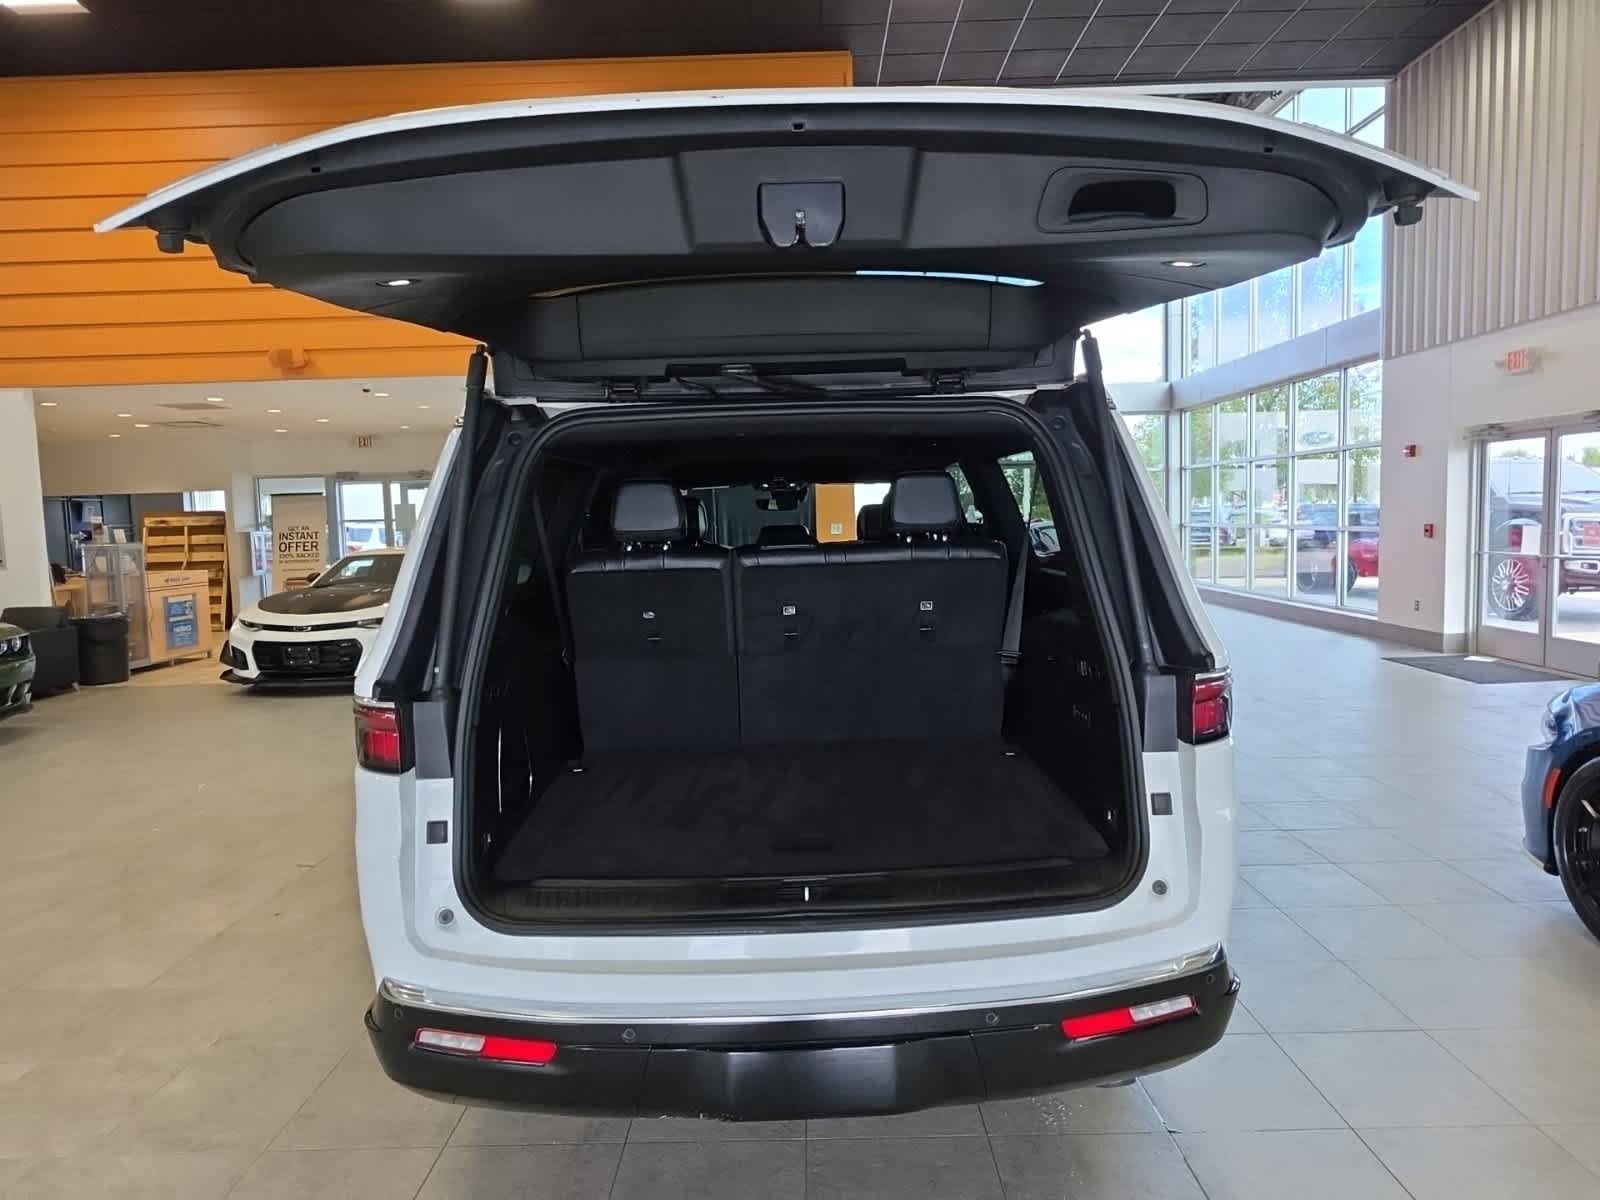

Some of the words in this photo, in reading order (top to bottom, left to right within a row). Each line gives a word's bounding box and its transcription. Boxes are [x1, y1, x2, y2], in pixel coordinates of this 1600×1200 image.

[358, 435, 373, 448] EXIT
[279, 531, 319, 541] INSTANT
[278, 541, 319, 552] OFFER
